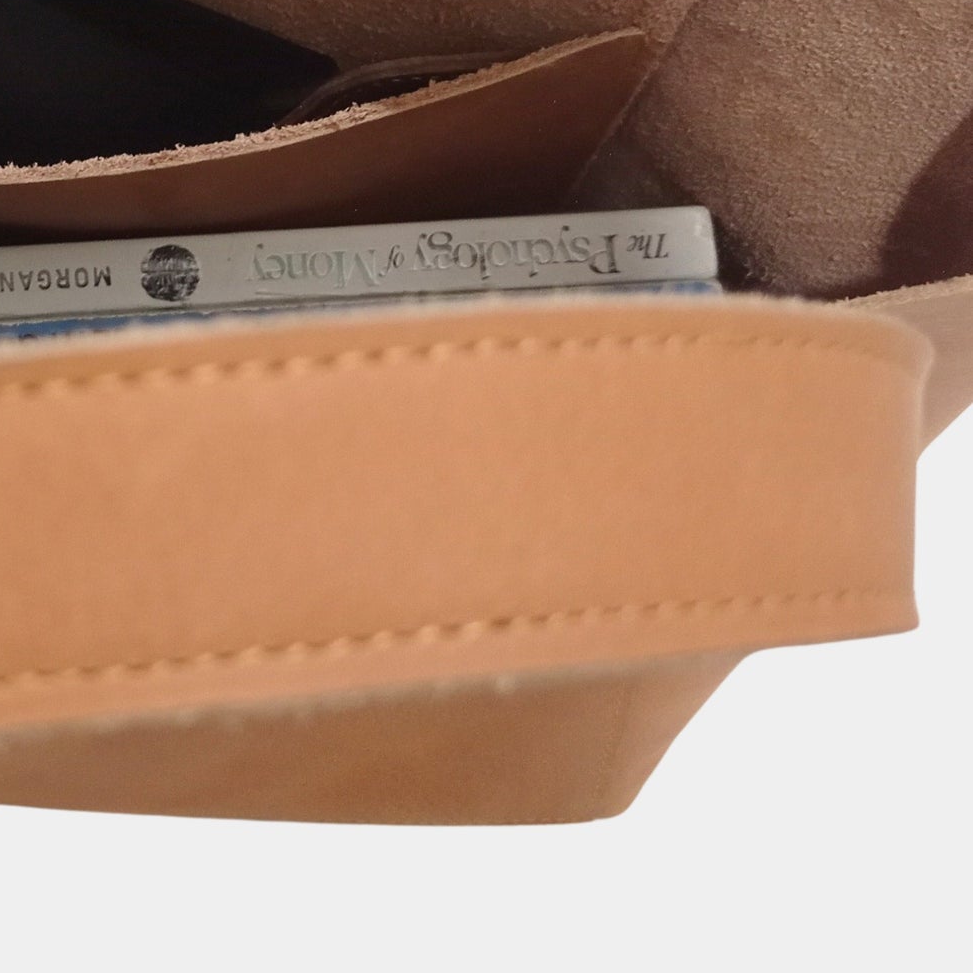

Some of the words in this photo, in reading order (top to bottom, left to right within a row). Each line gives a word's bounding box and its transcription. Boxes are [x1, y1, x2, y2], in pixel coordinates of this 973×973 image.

[379, 244, 405, 277] of
[411, 225, 621, 280] Psychology
[626, 232, 669, 259] The
[0, 266, 112, 292] MORGAN
[246, 243, 379, 289] Money
